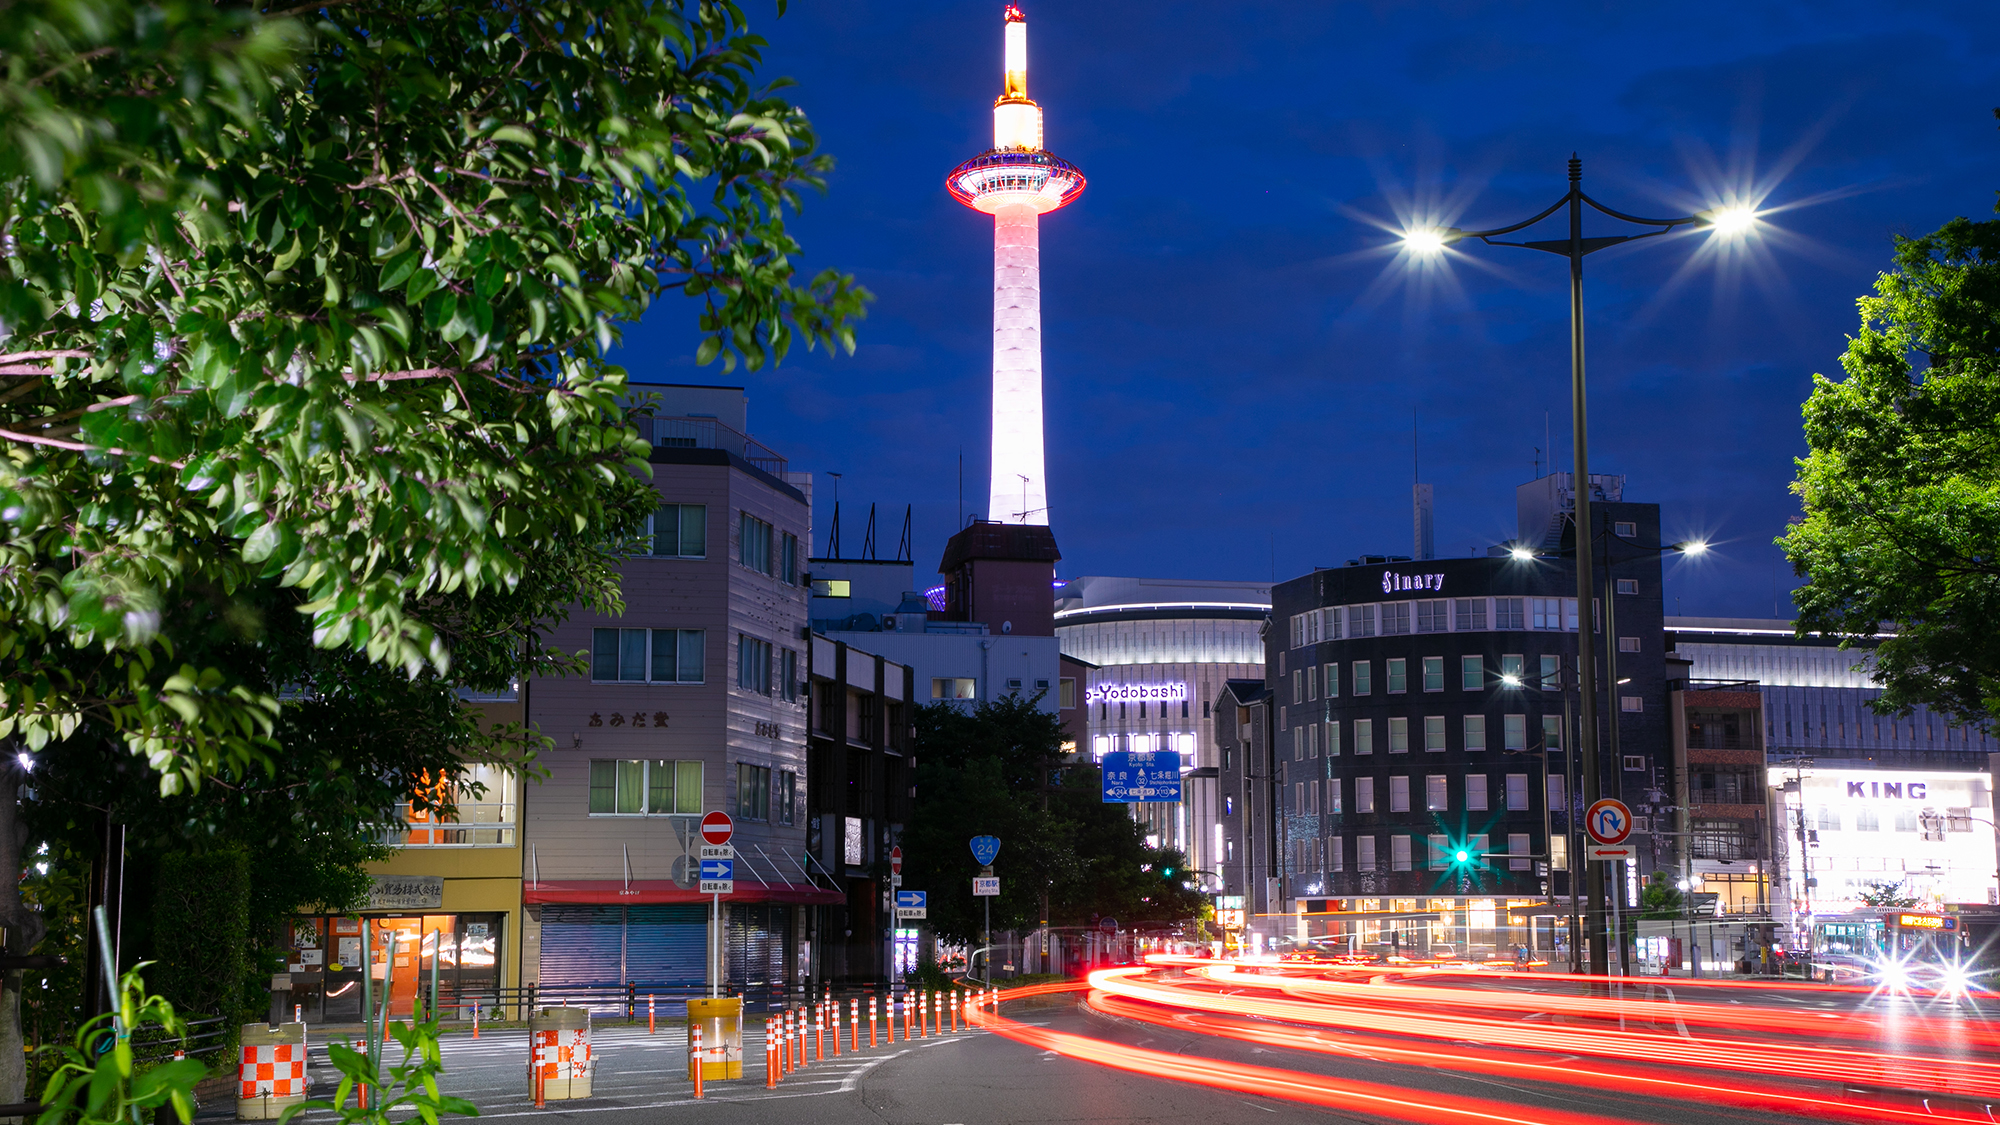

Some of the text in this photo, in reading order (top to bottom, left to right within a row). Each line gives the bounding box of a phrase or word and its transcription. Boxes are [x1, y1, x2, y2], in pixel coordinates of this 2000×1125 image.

[1382, 571, 1445, 594] Sinary
[588, 711, 670, 728] あみだ堂
[1127, 753, 1156, 762] 京都駅
[1107, 771, 1127, 780] 奈良
[1150, 771, 1179, 780] 七条堀川
[1847, 781, 1926, 799] KING
[703, 848, 732, 856] 自転車を除く
[977, 844, 994, 855] 24
